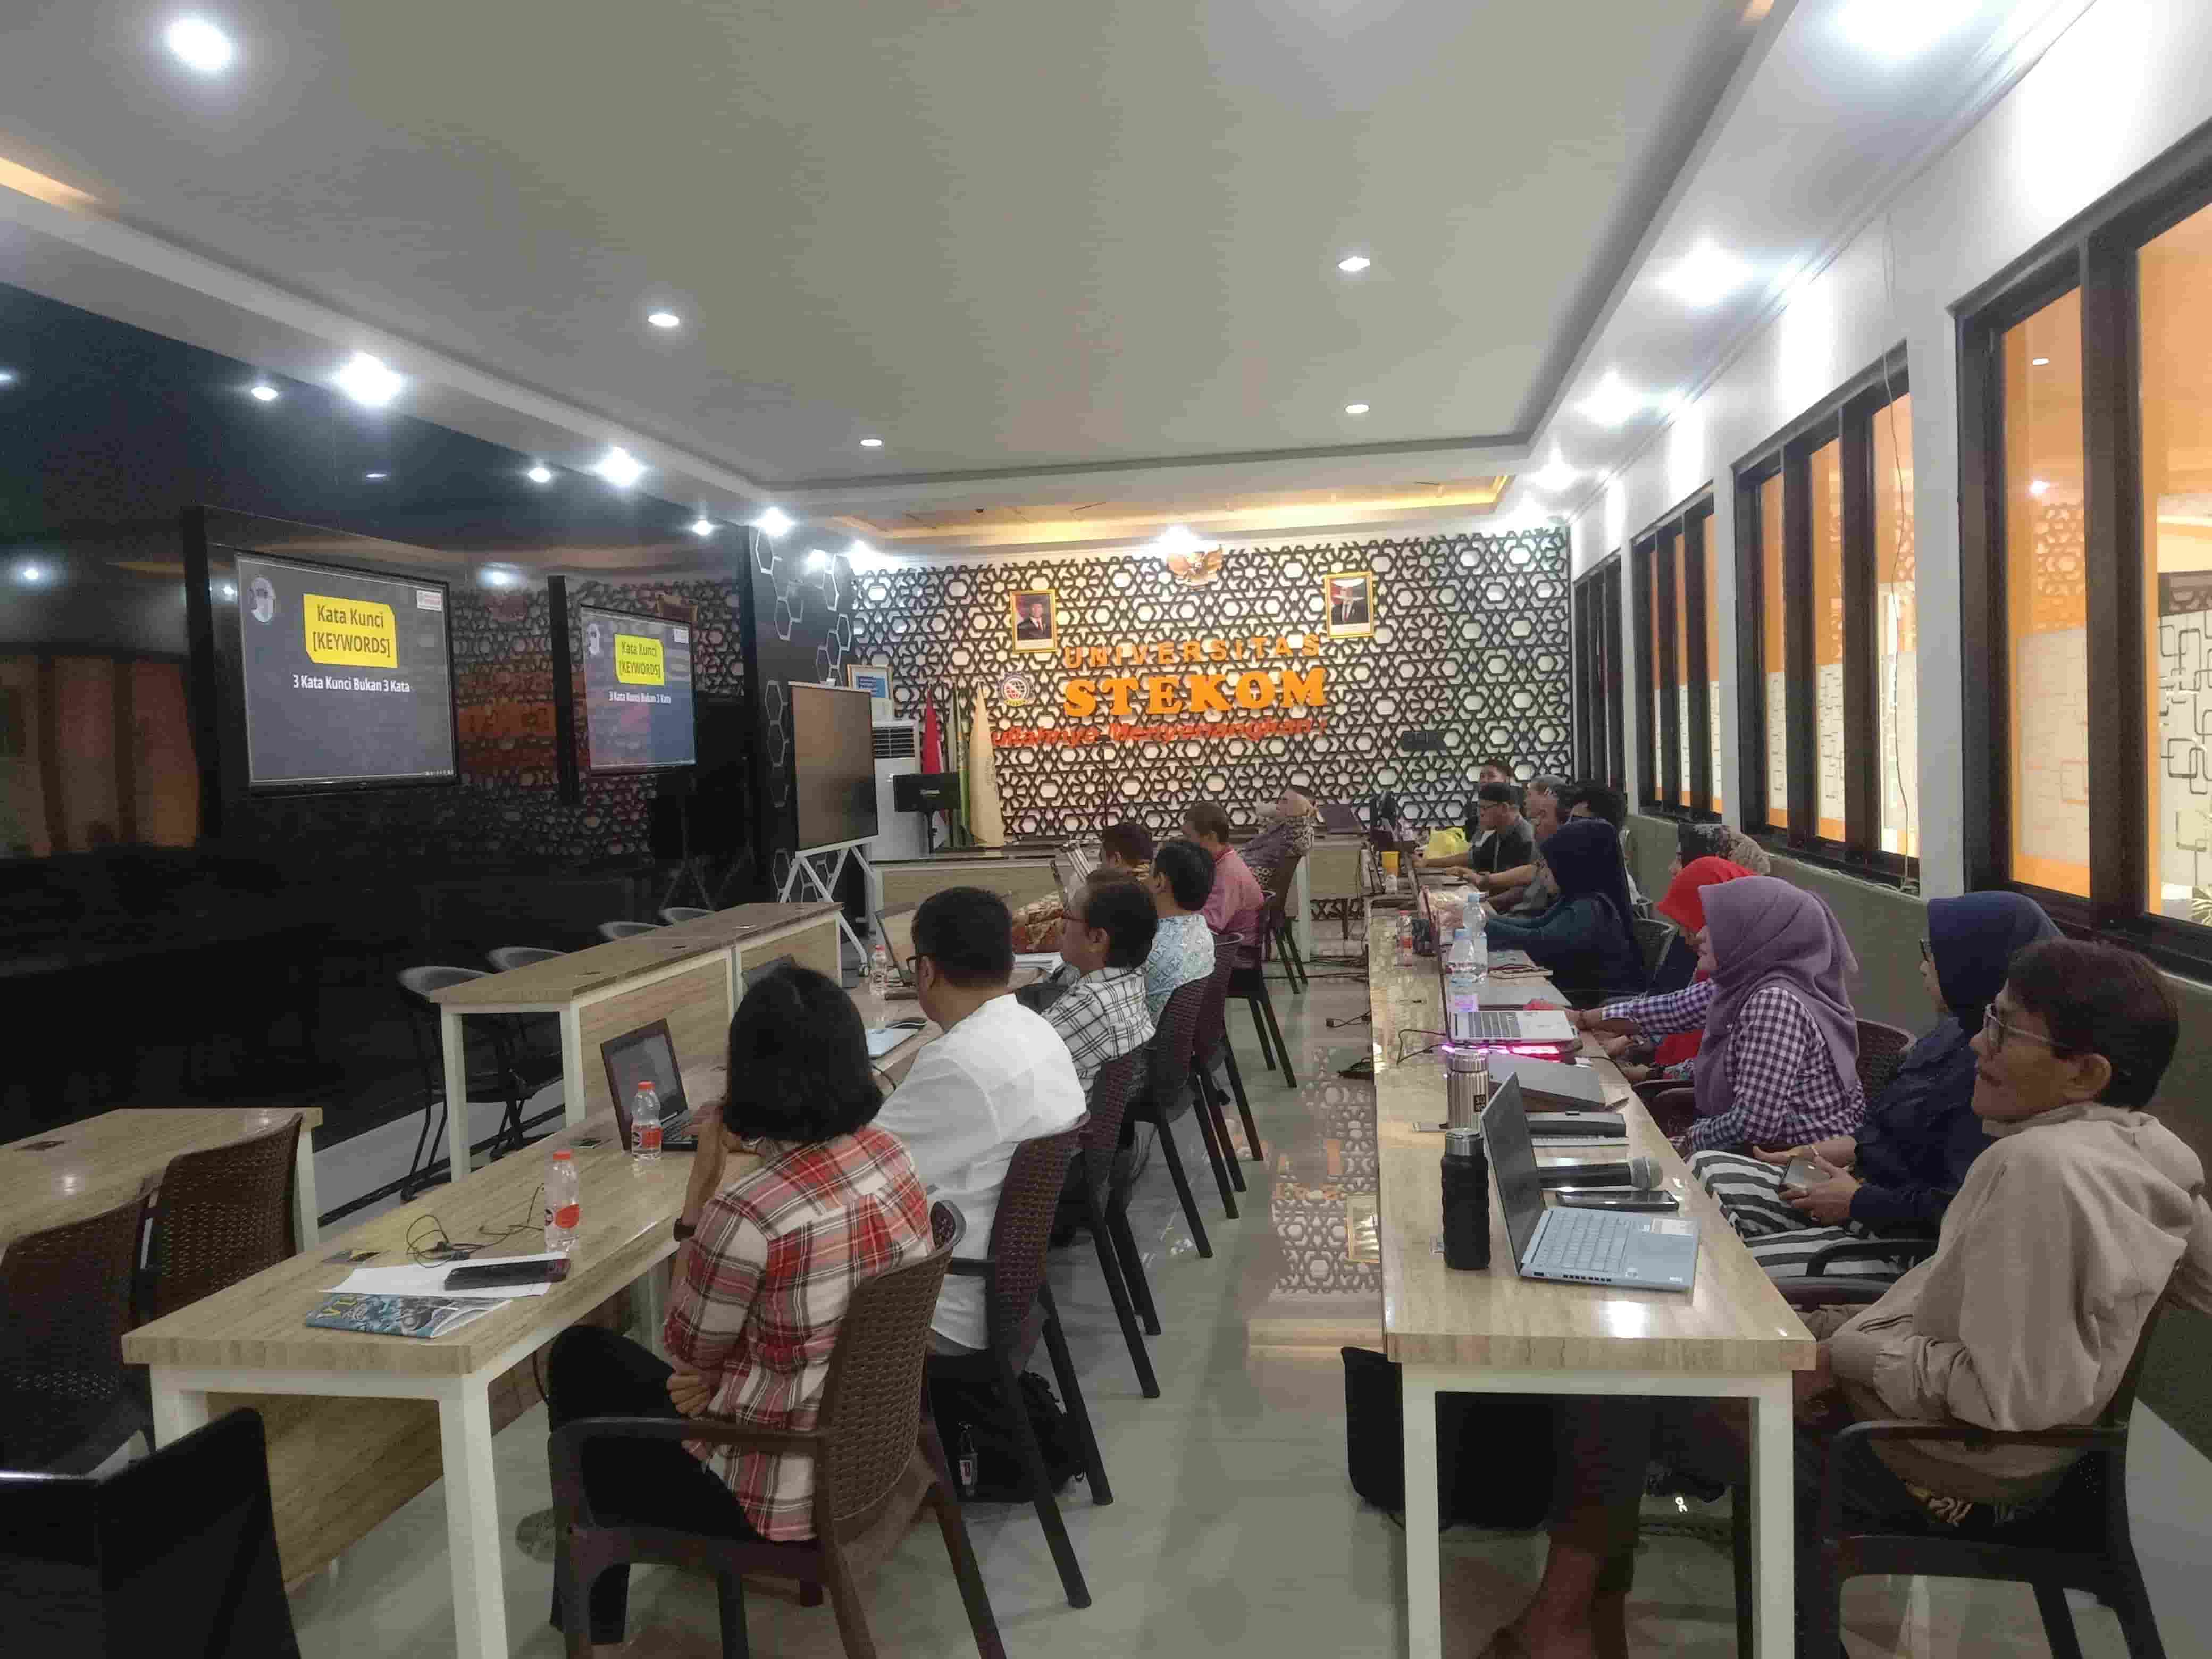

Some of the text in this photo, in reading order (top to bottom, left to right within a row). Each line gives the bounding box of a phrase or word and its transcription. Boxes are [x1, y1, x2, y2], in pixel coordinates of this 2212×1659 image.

[317, 604, 384, 629] Kata Kunci
[312, 631, 391, 658] [KEYWORDS]
[1064, 634, 1320, 668] UNIVERSITAS
[293, 674, 410, 692] 3 Kata Kunci Bukan 3 Kata
[1063, 668, 1327, 717] STEKOM
